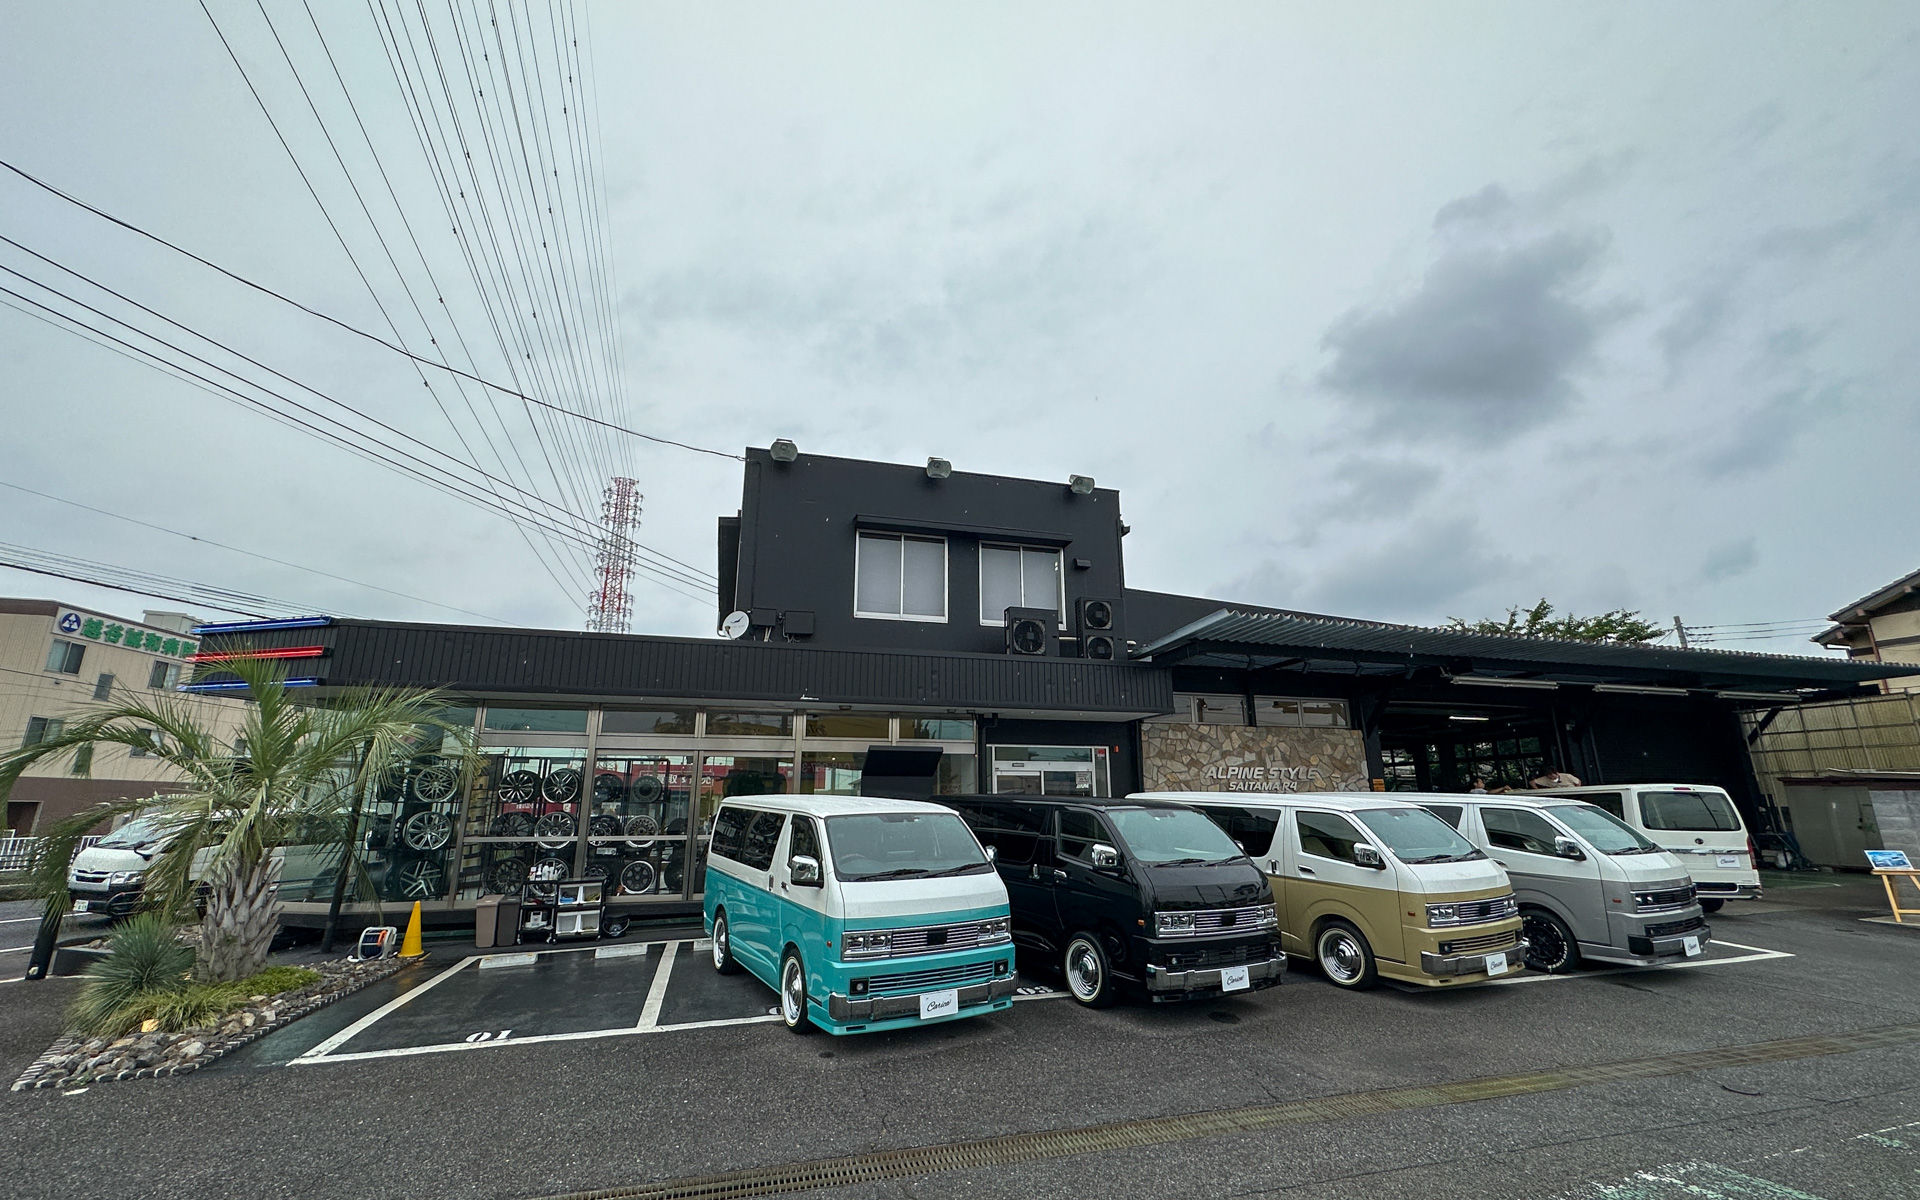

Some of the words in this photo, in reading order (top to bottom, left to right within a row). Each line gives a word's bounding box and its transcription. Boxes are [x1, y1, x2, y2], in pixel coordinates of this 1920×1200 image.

[1205, 766, 1265, 779] ALPINE
[1268, 767, 1318, 780] STYLE
[1228, 781, 1280, 791] SAITAMA
[1282, 781, 1298, 791] R4
[465, 1030, 512, 1042] 01
